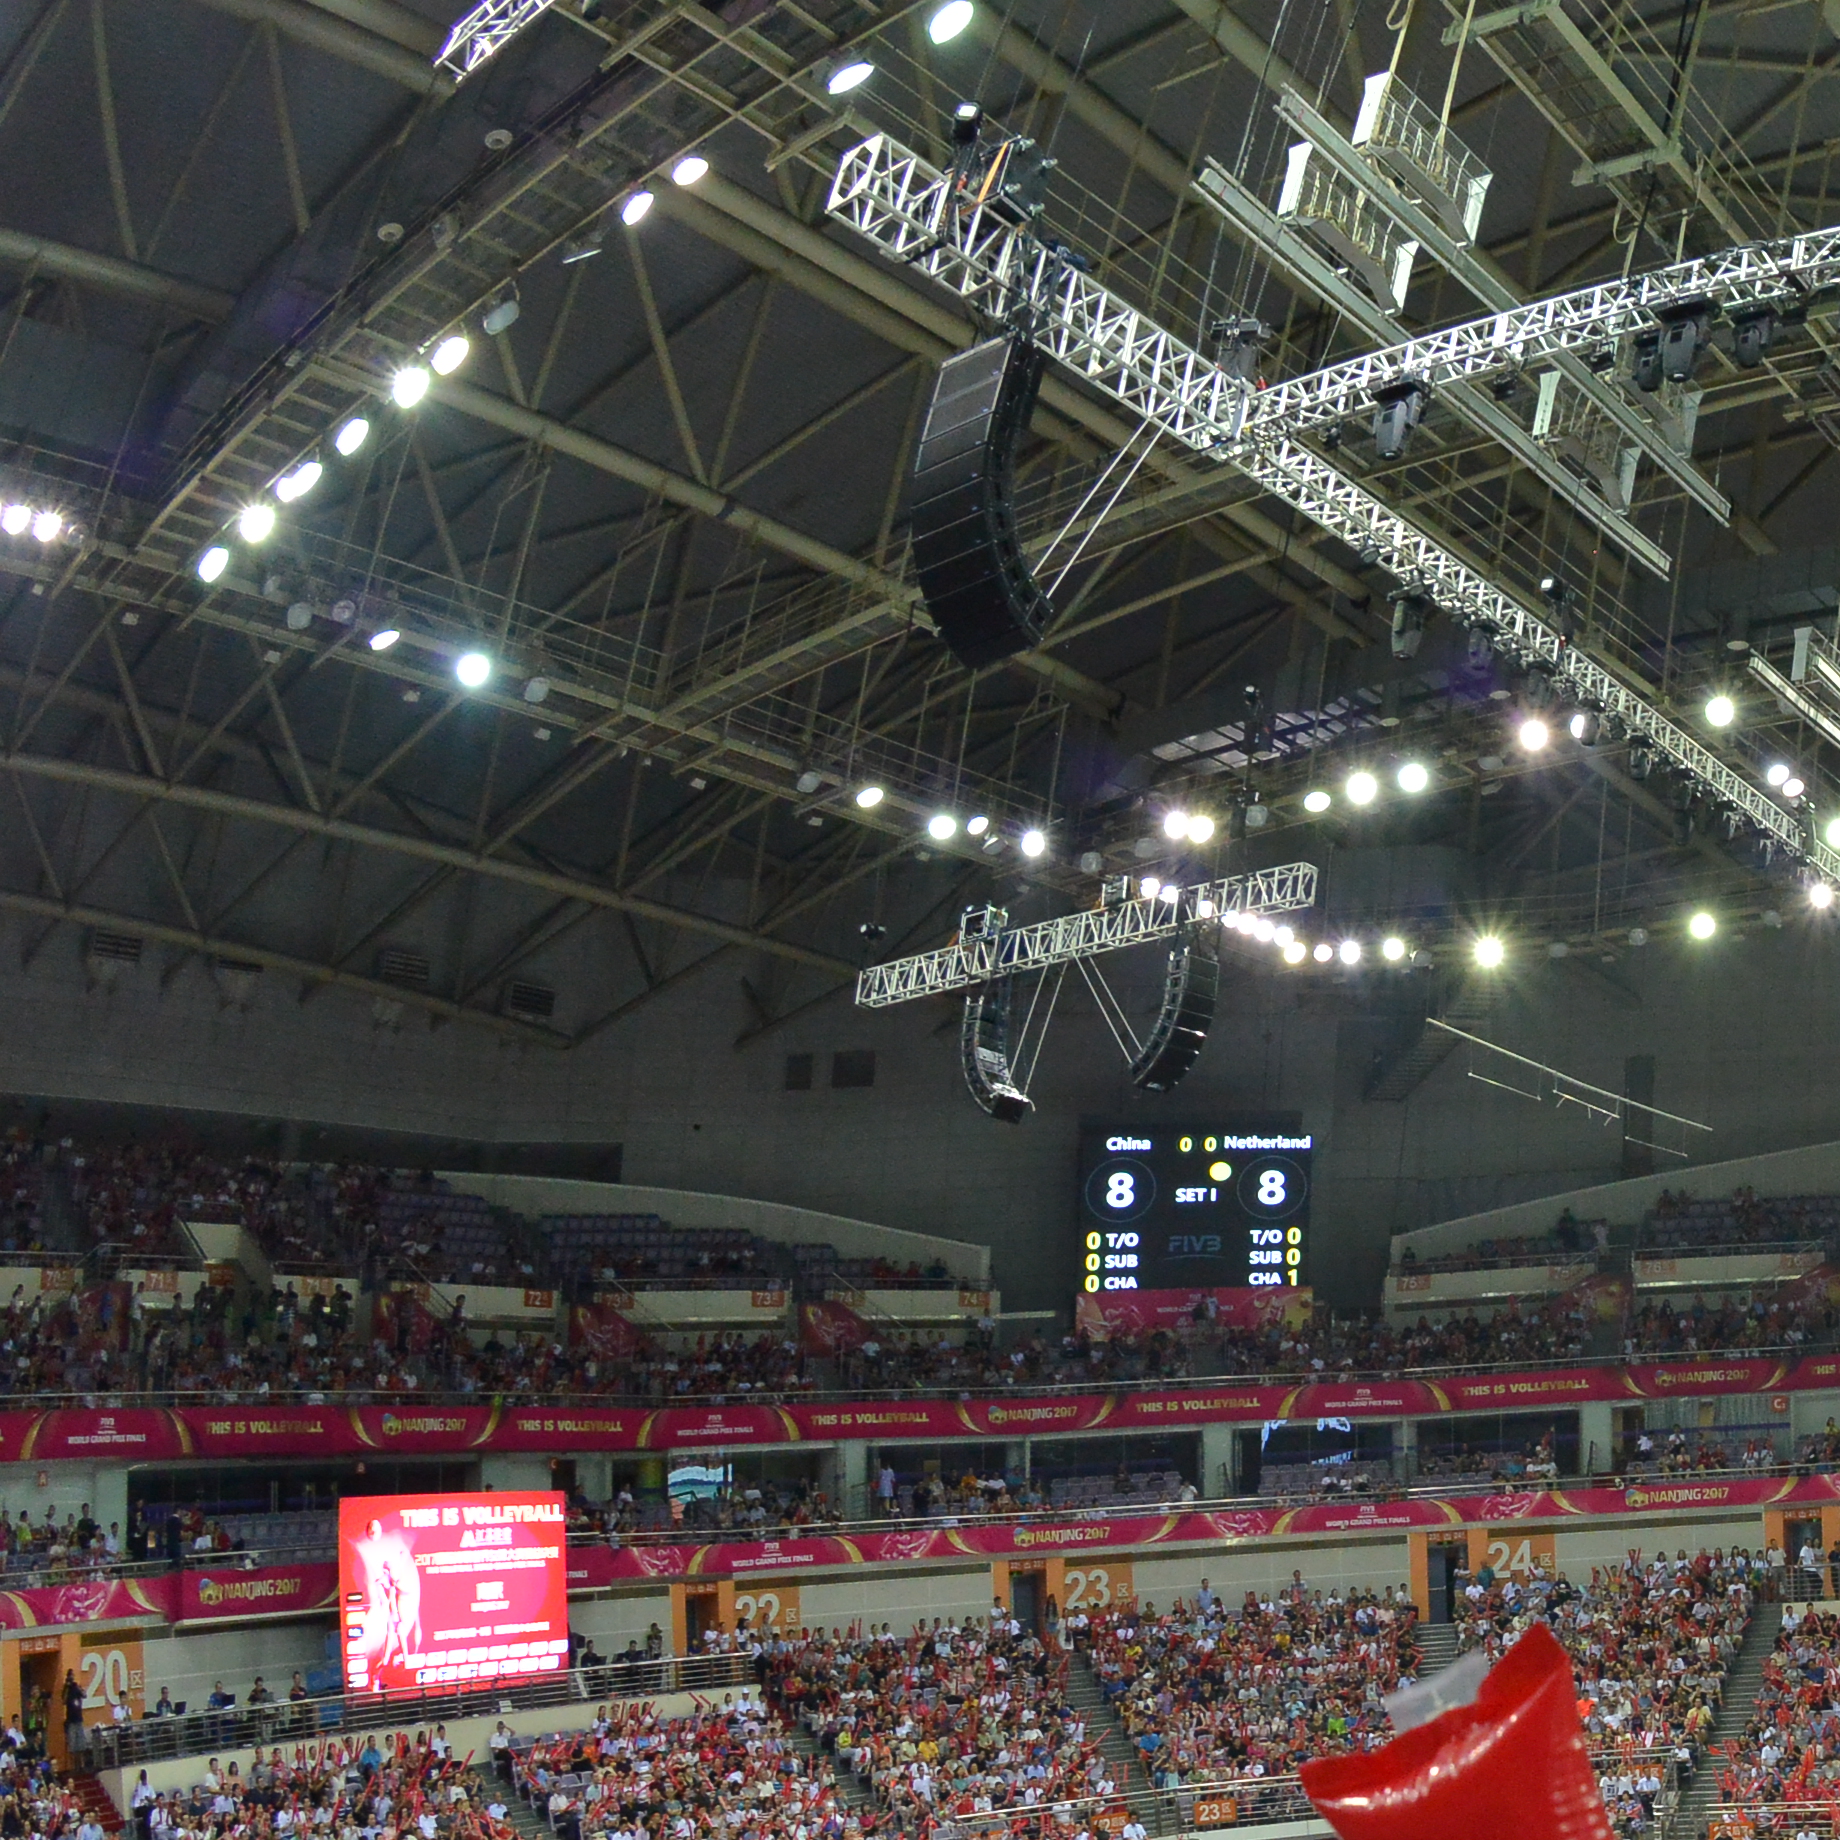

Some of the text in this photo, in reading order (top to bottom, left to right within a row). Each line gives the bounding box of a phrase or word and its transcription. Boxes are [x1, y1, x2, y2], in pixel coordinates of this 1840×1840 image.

[1106, 1137, 1151, 1151] China
[1180, 1137, 1217, 1152] 0 0
[1224, 1136, 1311, 1149] Netherland
[1106, 1172, 1135, 1208] 8
[1175, 1188, 1207, 1202] SET
[1258, 1170, 1285, 1205] 8
[1087, 1232, 1139, 1250] 0 T/O
[1169, 1235, 1221, 1252] FIVB
[1250, 1227, 1301, 1245] T/O 0
[1086, 1253, 1138, 1271] 0 SUB
[1249, 1248, 1300, 1266] SUB 0
[1085, 1275, 1137, 1293] 0 CHA
[1249, 1269, 1298, 1286] CHA 1
[463, 1504, 564, 1525] VOLLEYBALL
[1488, 1540, 1532, 1578] 24
[1065, 1569, 1111, 1610] 23
[80, 1650, 128, 1700] 20
